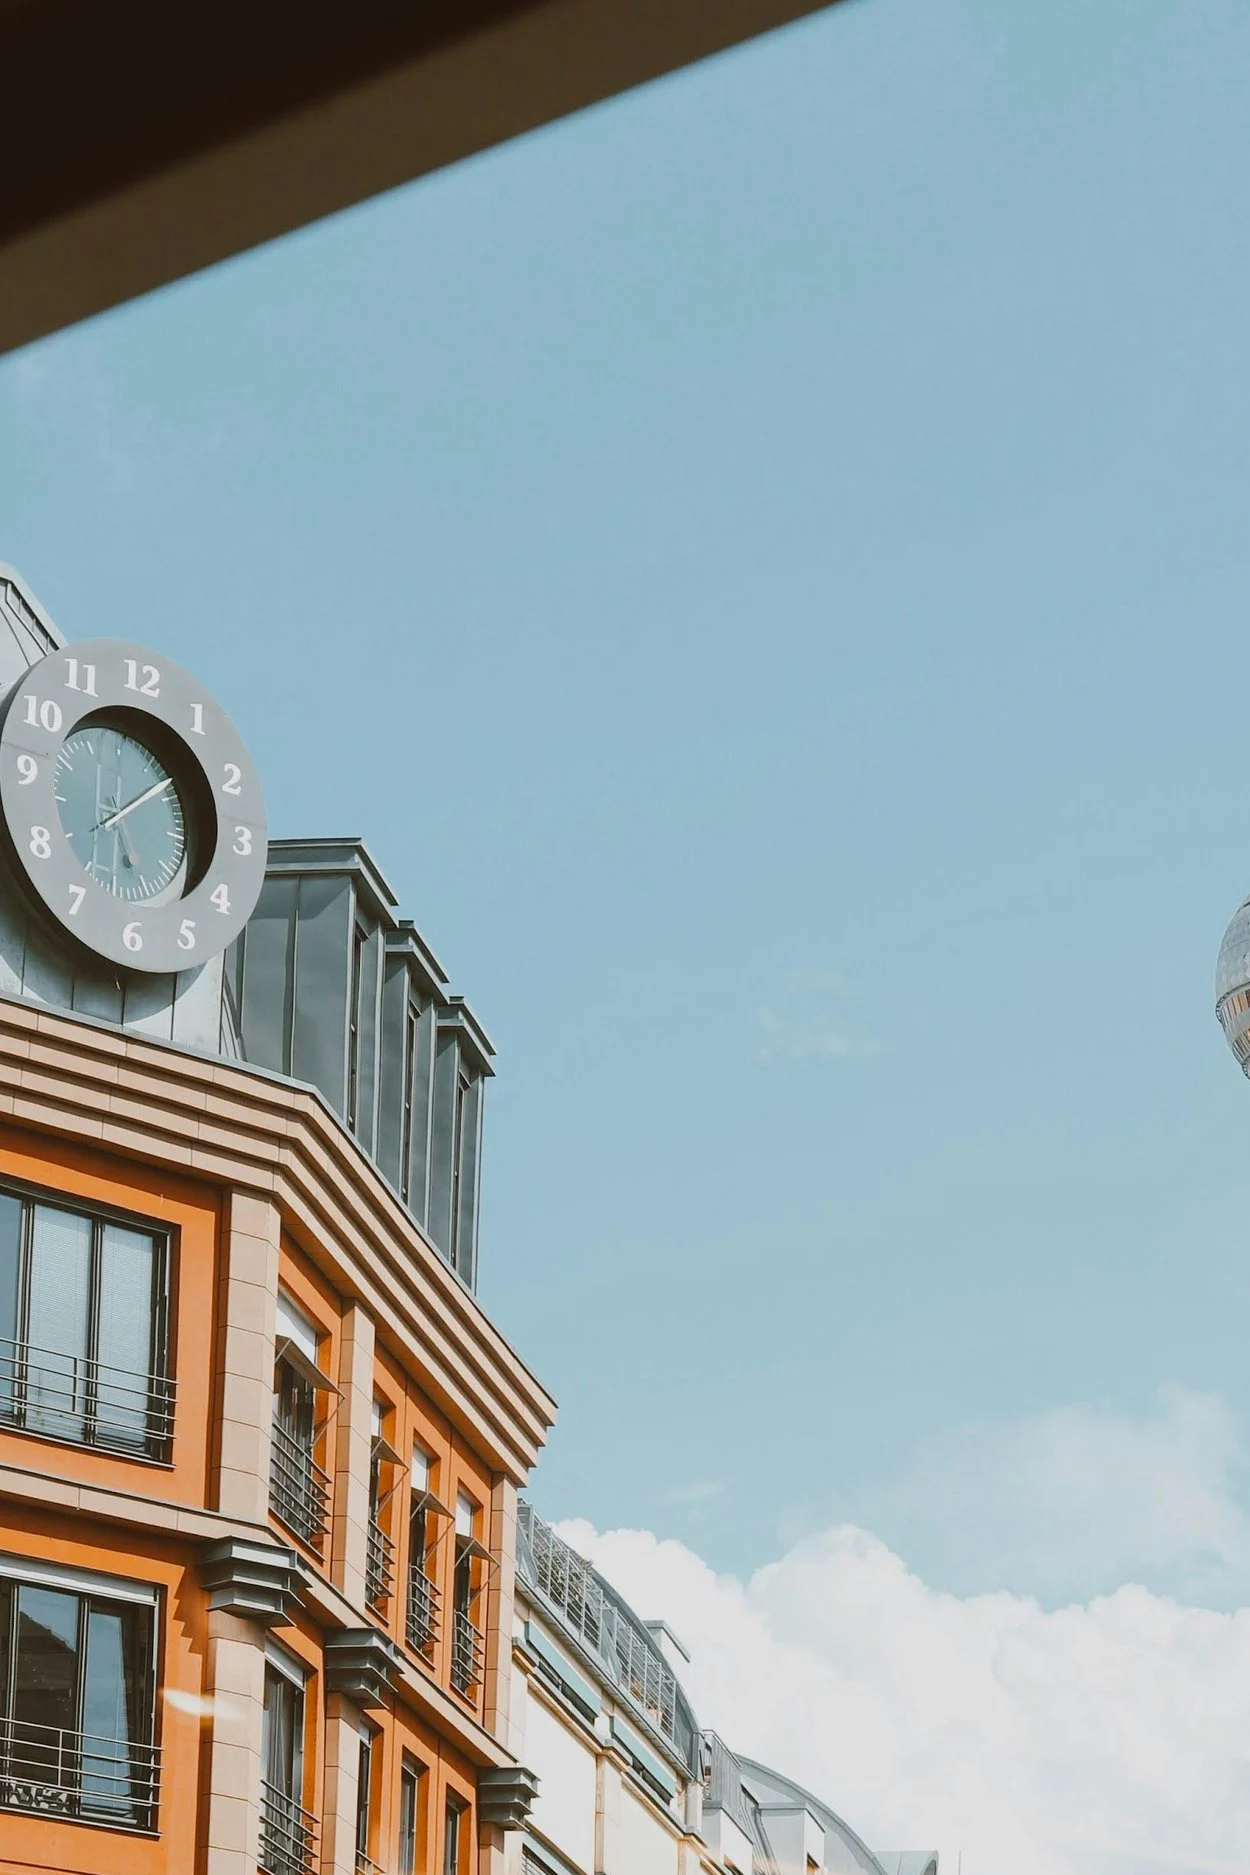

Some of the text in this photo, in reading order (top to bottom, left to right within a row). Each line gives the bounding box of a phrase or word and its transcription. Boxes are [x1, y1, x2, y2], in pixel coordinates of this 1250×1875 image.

[64, 658, 99, 698] 11
[123, 658, 161, 699] 12
[23, 694, 63, 733] 10
[190, 703, 206, 736] 1
[16, 754, 38, 786] 9
[221, 762, 243, 796] 2
[29, 825, 52, 860] 8
[232, 825, 253, 857] 3
[67, 884, 87, 917] 7
[209, 883, 232, 916] 4
[122, 921, 144, 953] 6
[176, 919, 197, 952] 5
